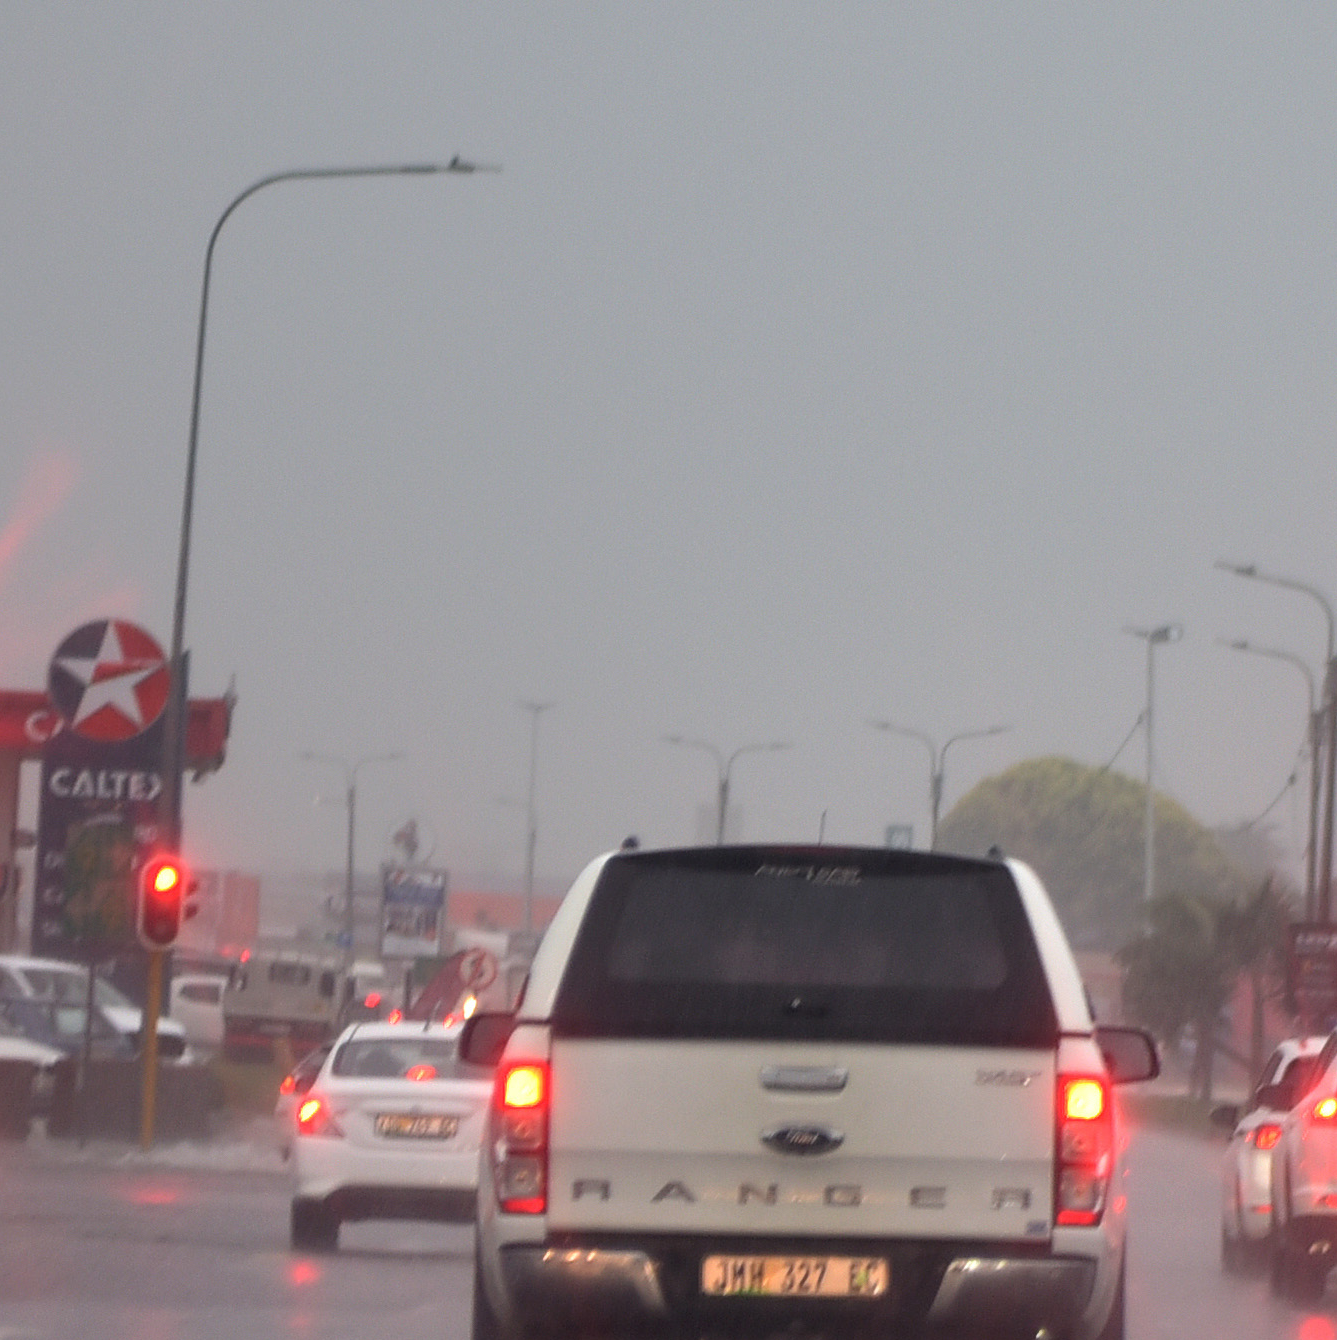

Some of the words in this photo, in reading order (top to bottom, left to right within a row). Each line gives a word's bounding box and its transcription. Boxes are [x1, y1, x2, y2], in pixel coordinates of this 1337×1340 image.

[570, 1178, 1032, 1211] RANGER
[781, 1258, 830, 1294] 327
[848, 1260, 885, 1295] EC
